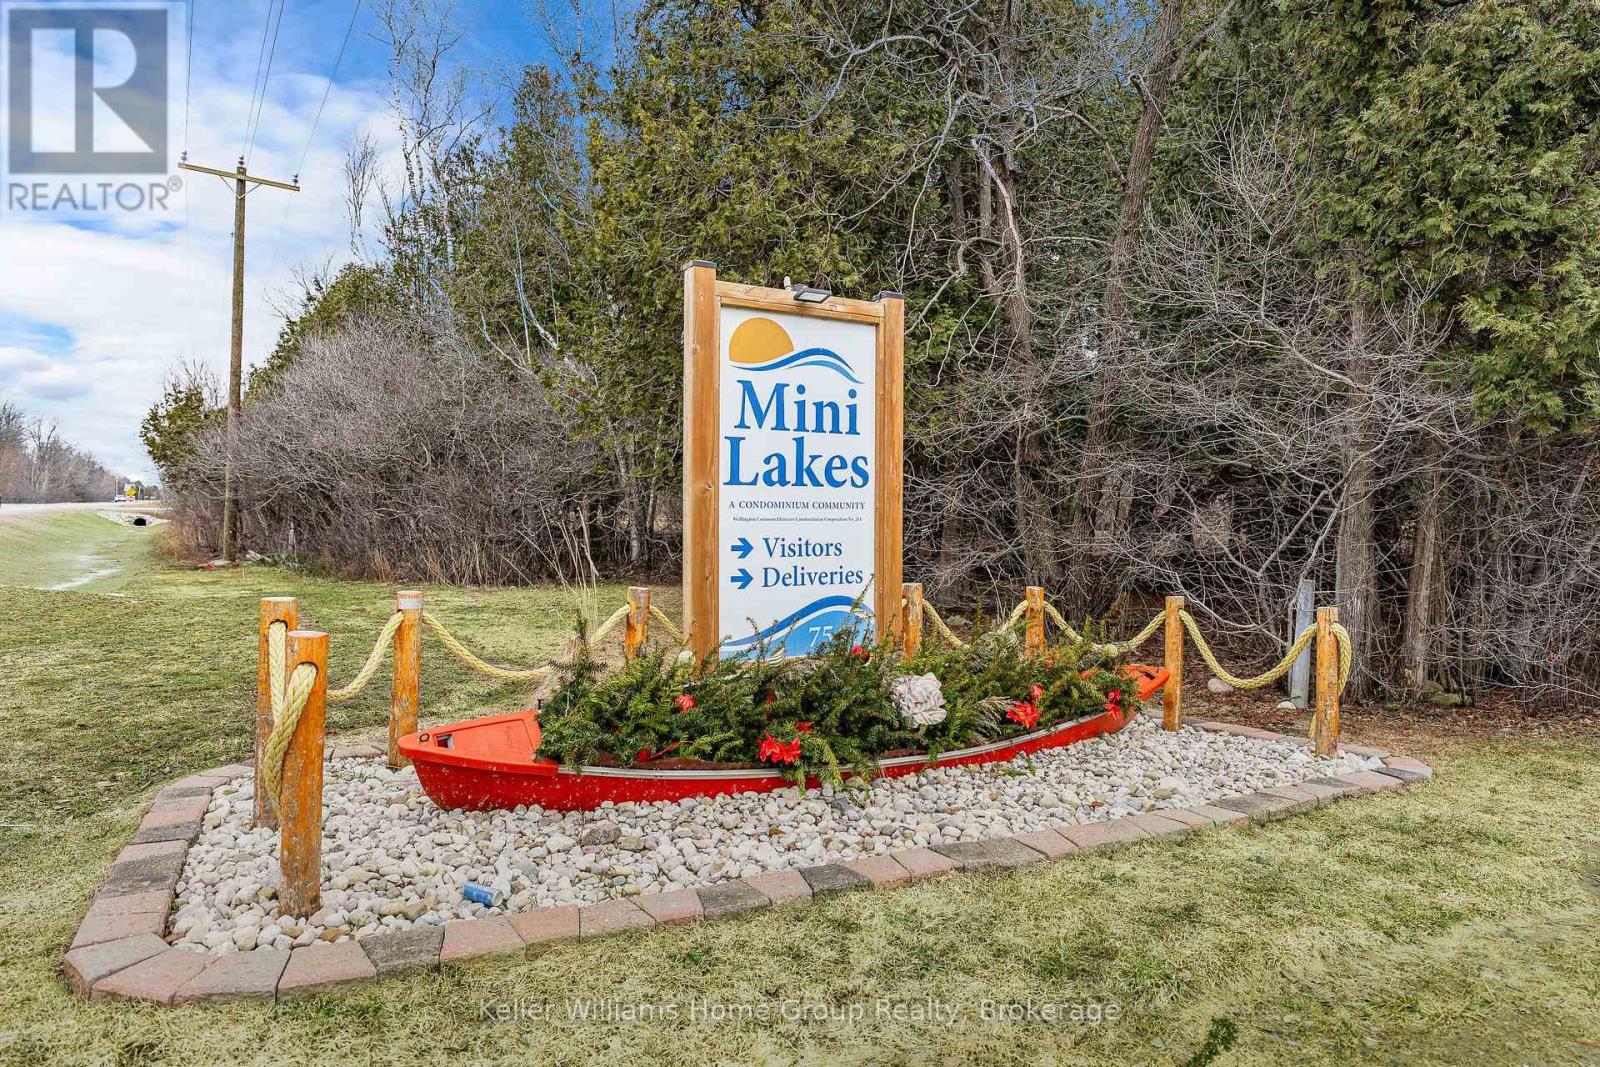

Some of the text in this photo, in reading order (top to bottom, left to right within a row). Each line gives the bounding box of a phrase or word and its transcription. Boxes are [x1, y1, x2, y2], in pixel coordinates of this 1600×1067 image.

[734, 379, 861, 435] Mini
[723, 436, 870, 488] Lakes
[728, 500, 866, 510] A CONDOMINIUM COMMUNITY
[762, 537, 843, 558] Visitors
[762, 565, 864, 588] Deliveries
